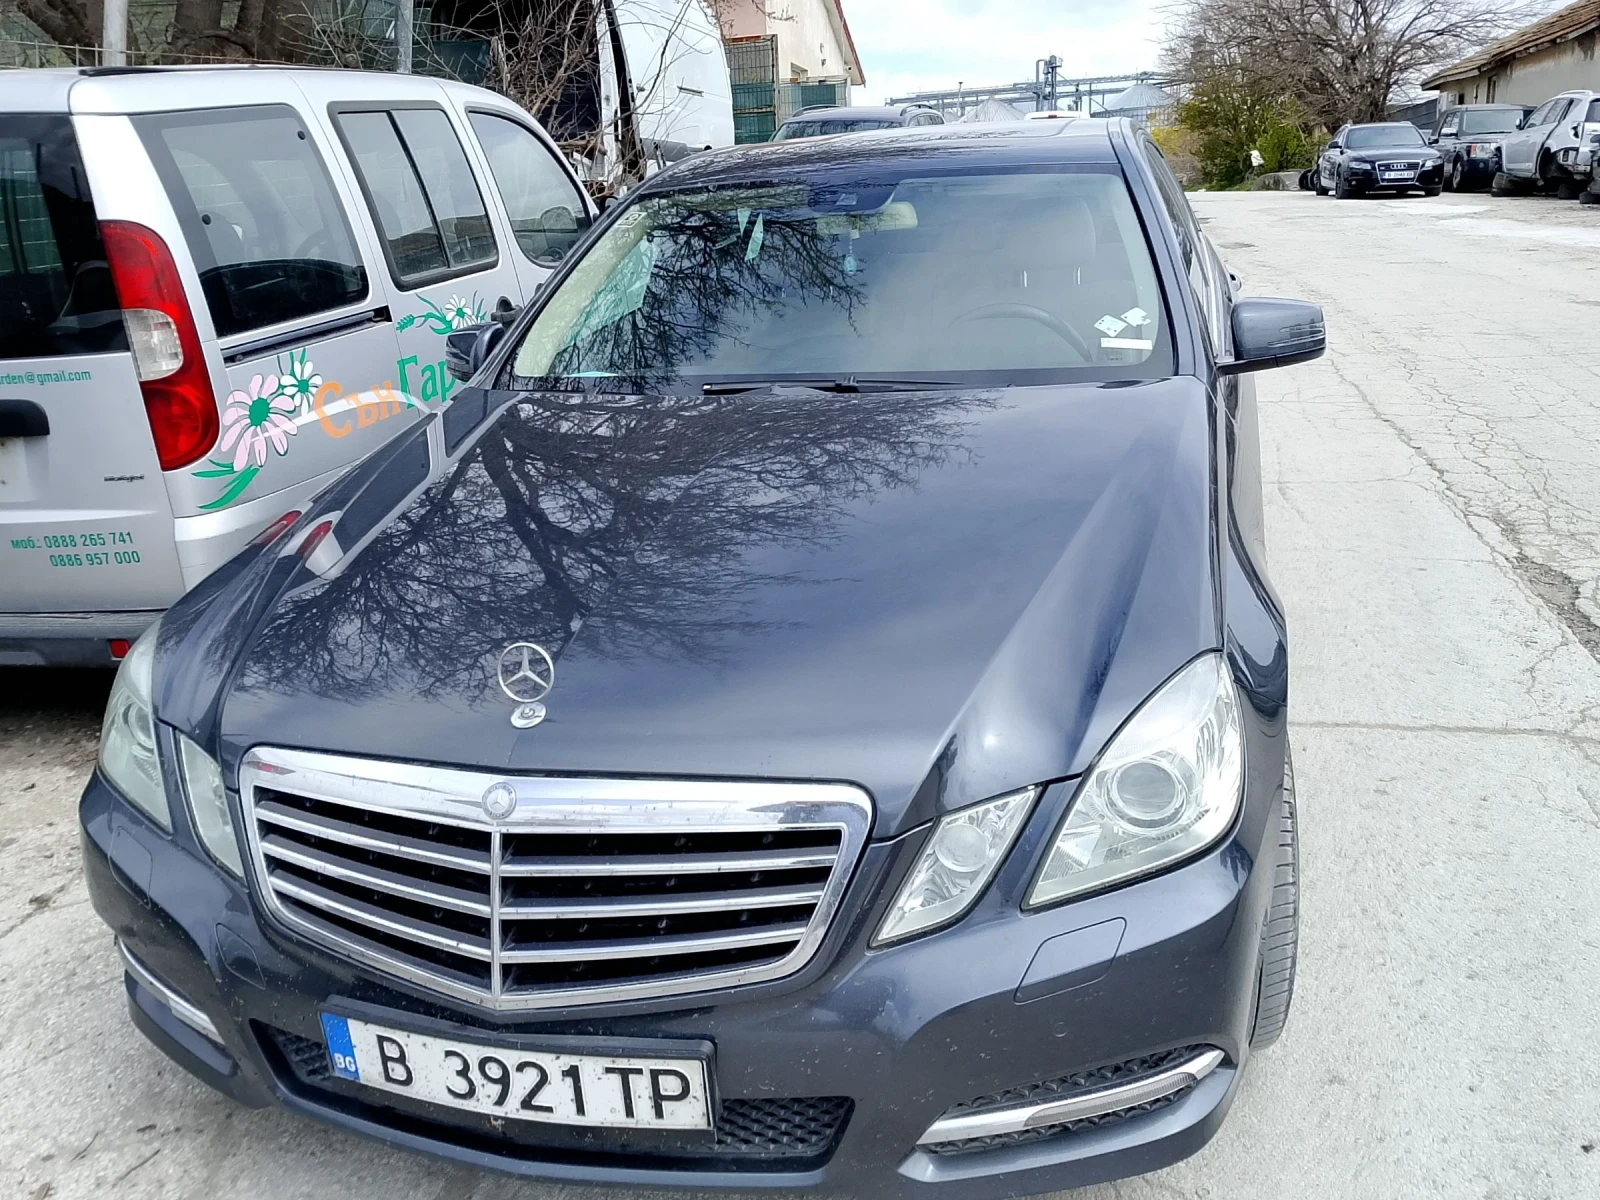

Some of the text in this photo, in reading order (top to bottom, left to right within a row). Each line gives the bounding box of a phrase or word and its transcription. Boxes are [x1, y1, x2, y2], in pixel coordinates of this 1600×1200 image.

[313, 354, 467, 439] Сън Гар
[43, 534, 77, 548] 0888
[80, 532, 106, 547] 265
[110, 531, 134, 545] 741
[49, 550, 141, 567] 0886 957 000
[333, 1052, 356, 1073] BG
[376, 1034, 691, 1120] B 3921 TP
